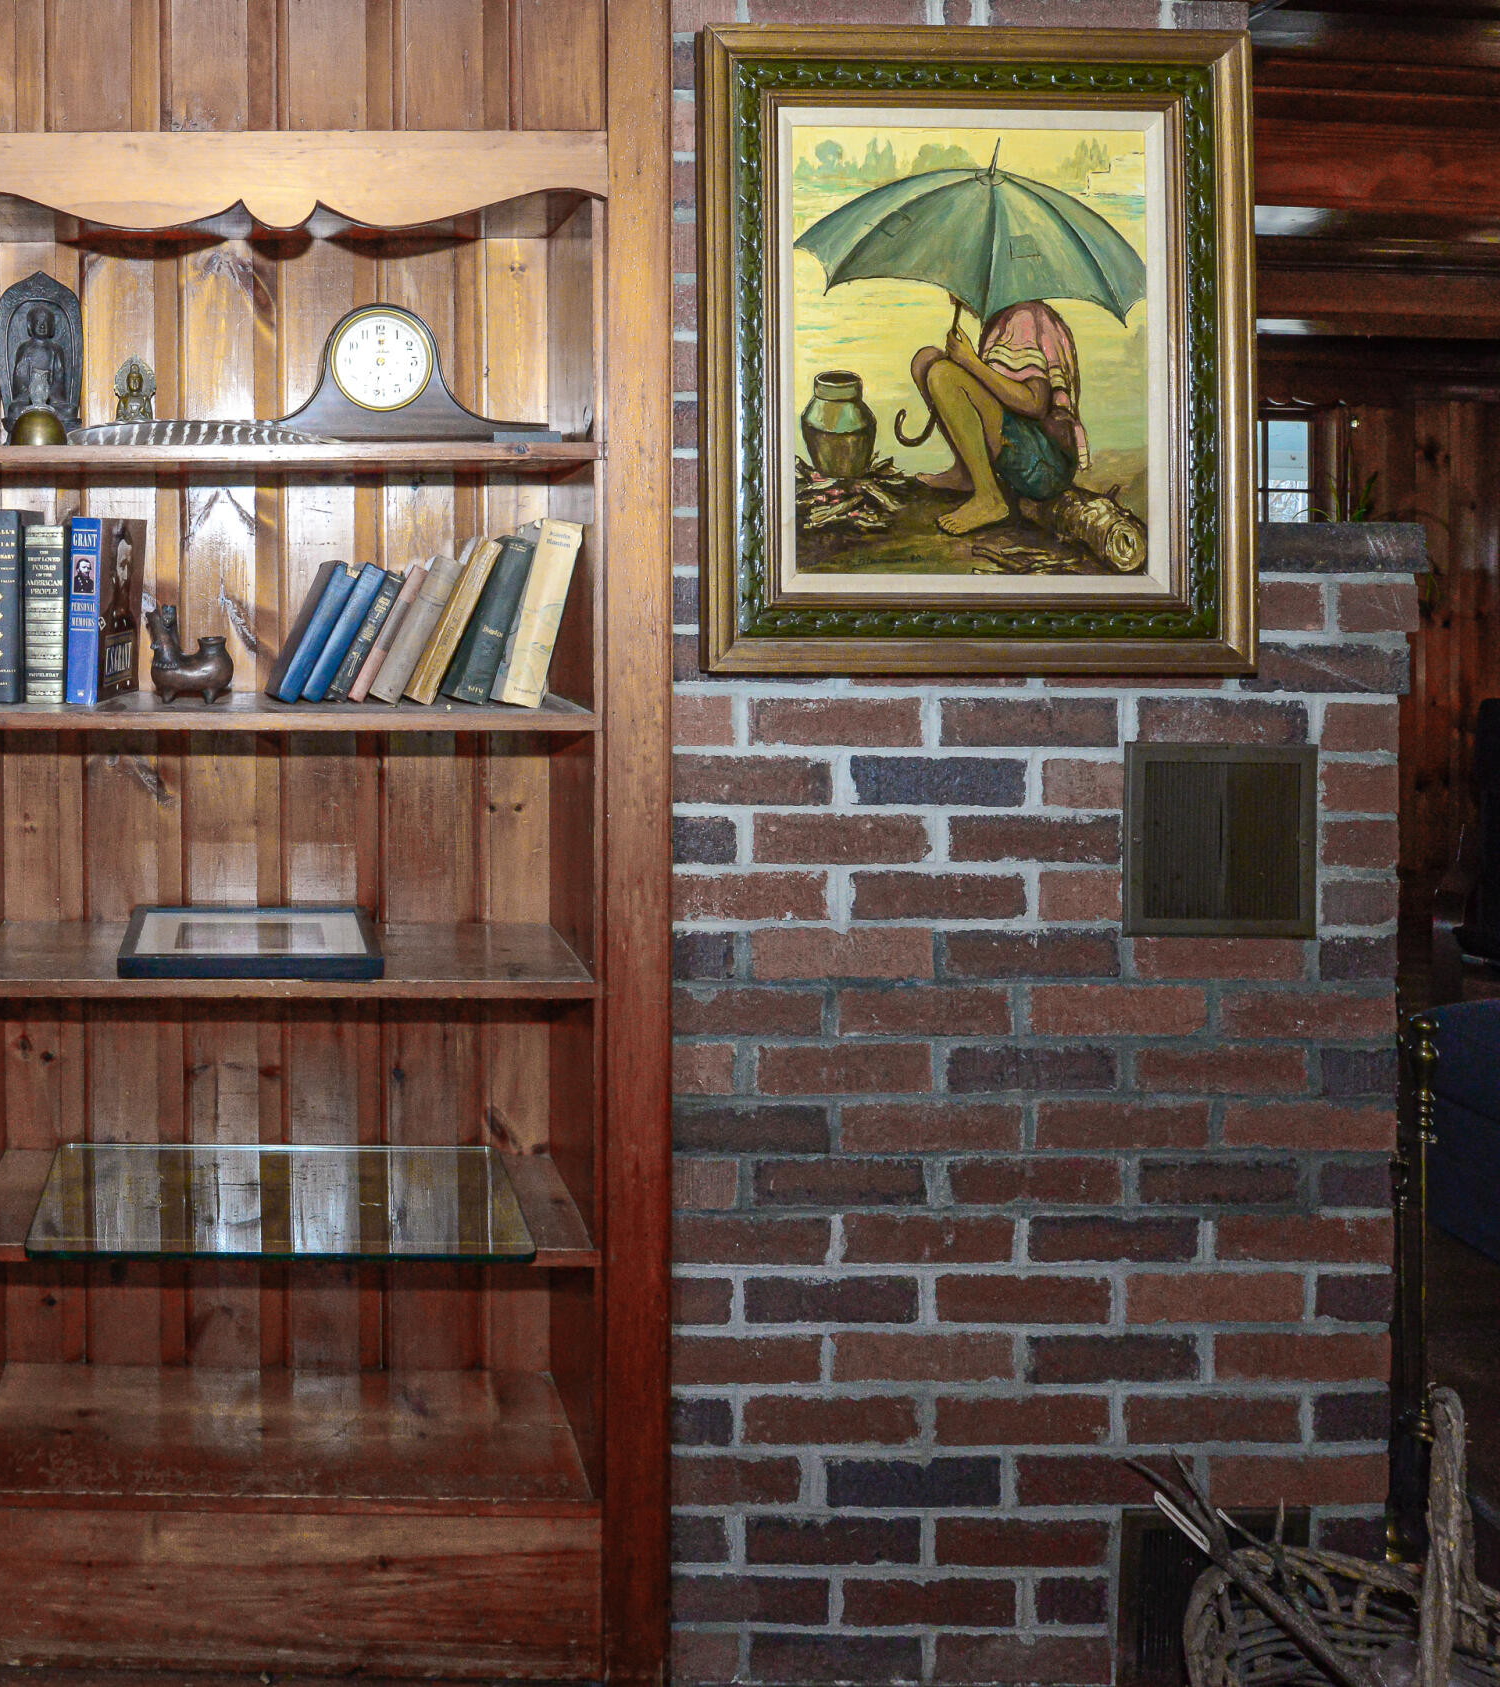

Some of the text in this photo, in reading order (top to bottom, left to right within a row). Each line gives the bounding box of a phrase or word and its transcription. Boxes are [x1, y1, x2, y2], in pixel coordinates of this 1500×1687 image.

[73, 533, 97, 548] GRANT
[26, 579, 63, 587] AMERICAN
[71, 602, 95, 613] PERSONAL
[71, 616, 95, 627] MEMOIRS
